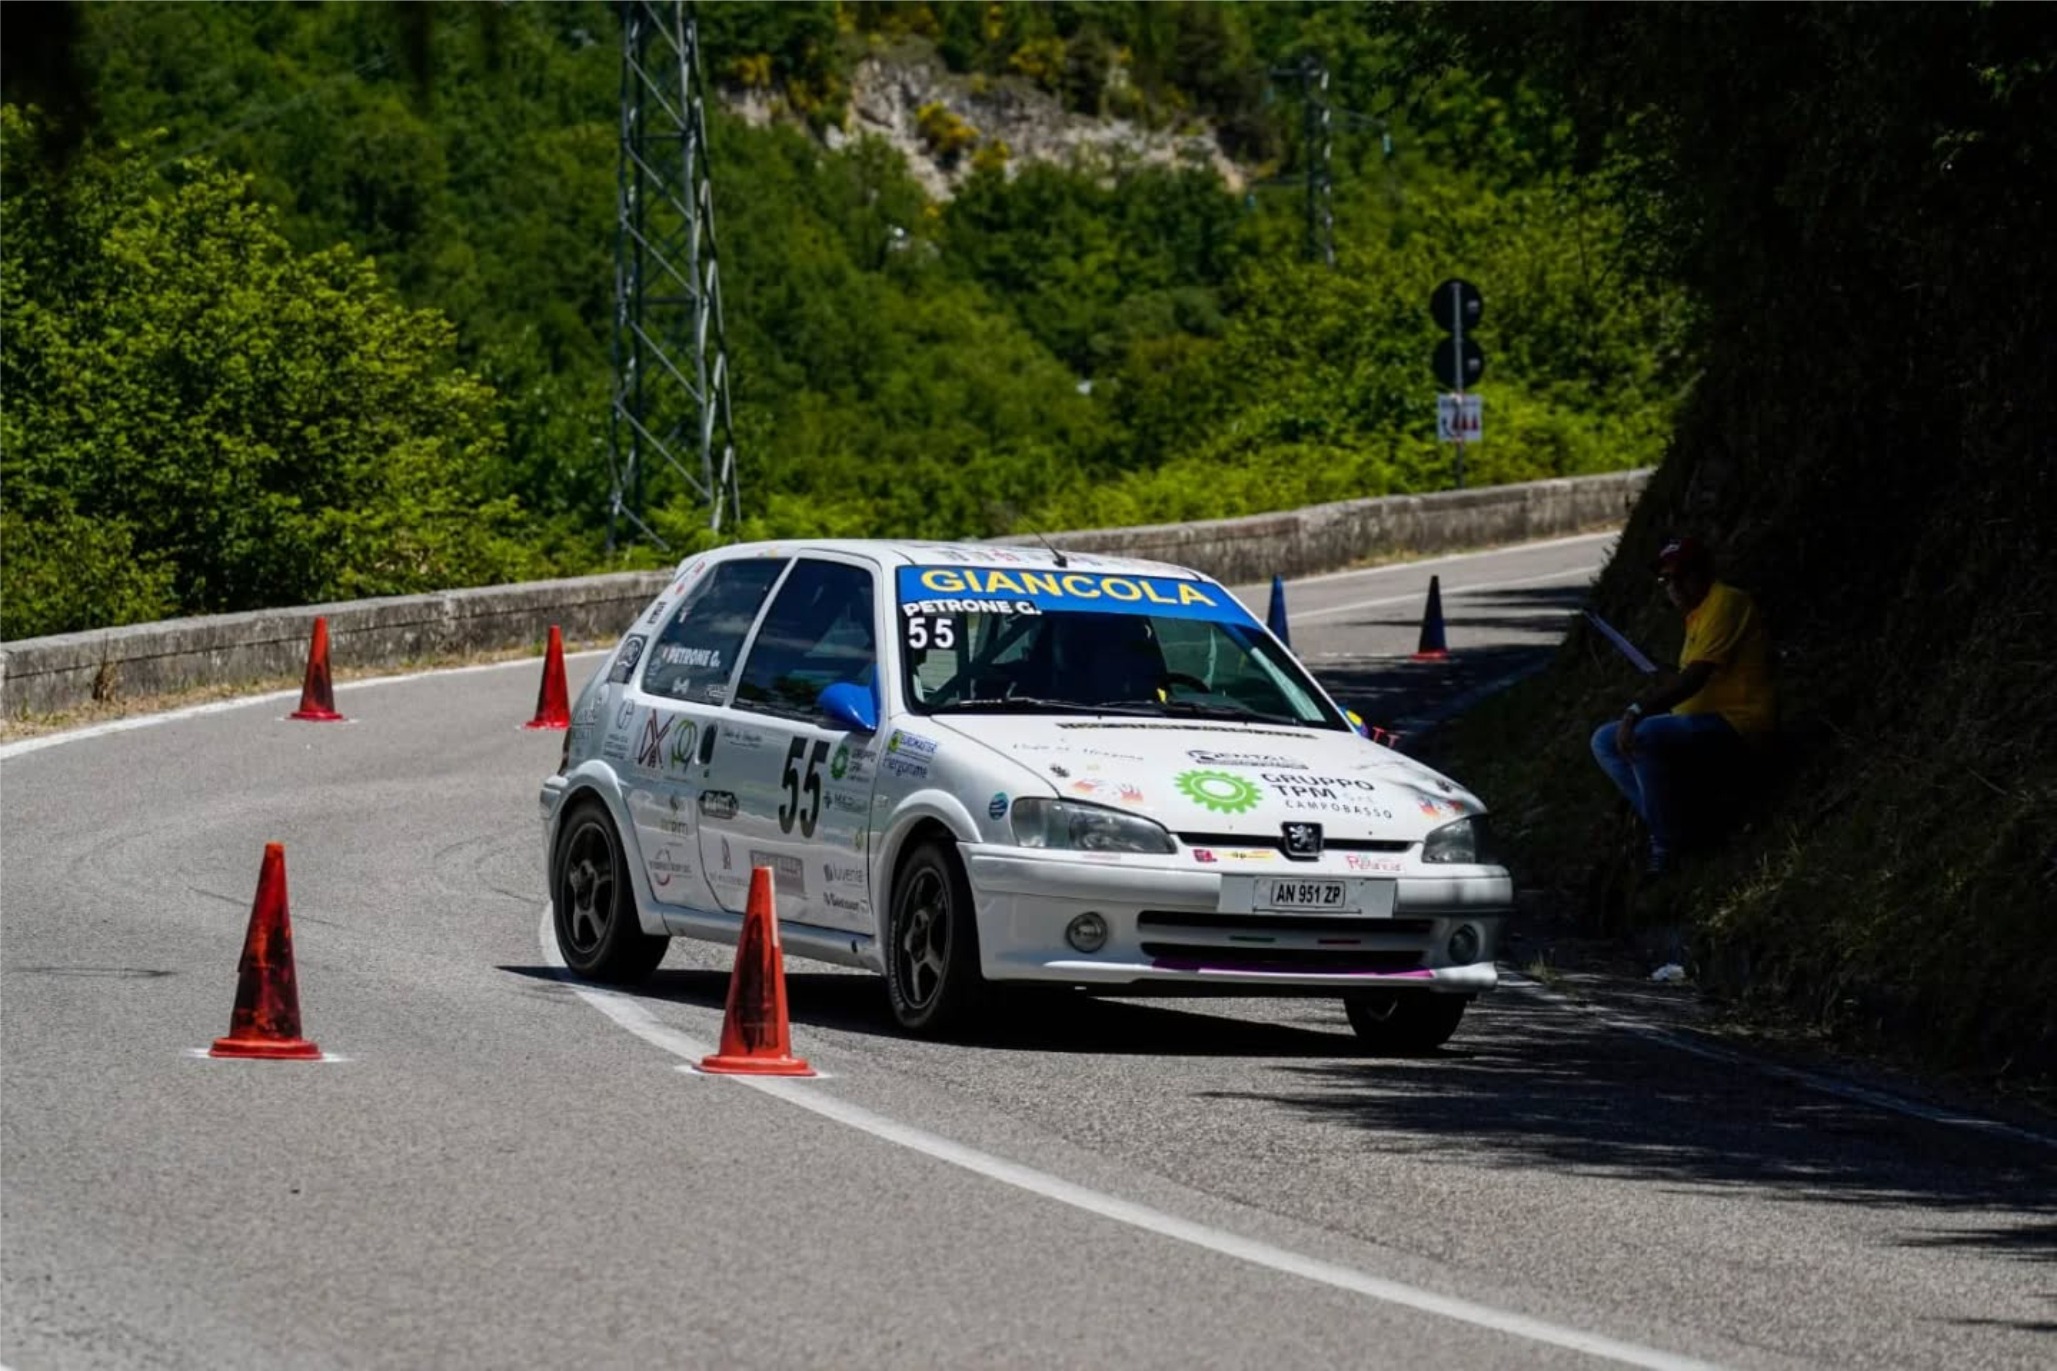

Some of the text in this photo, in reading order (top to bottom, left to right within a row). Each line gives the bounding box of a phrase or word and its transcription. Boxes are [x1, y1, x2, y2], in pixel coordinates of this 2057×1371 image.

[920, 569, 1218, 607] GIANCOLA
[902, 599, 1043, 617] PETRONE G.
[907, 617, 955, 649] 55
[666, 646, 712, 667] PETRONE
[778, 735, 832, 839] 55
[1260, 772, 1376, 792] GRUPPO
[1270, 784, 1338, 801] TPM
[1284, 799, 1394, 819] CAMPOBASSO
[1276, 884, 1341, 904] AN 951 ZP
